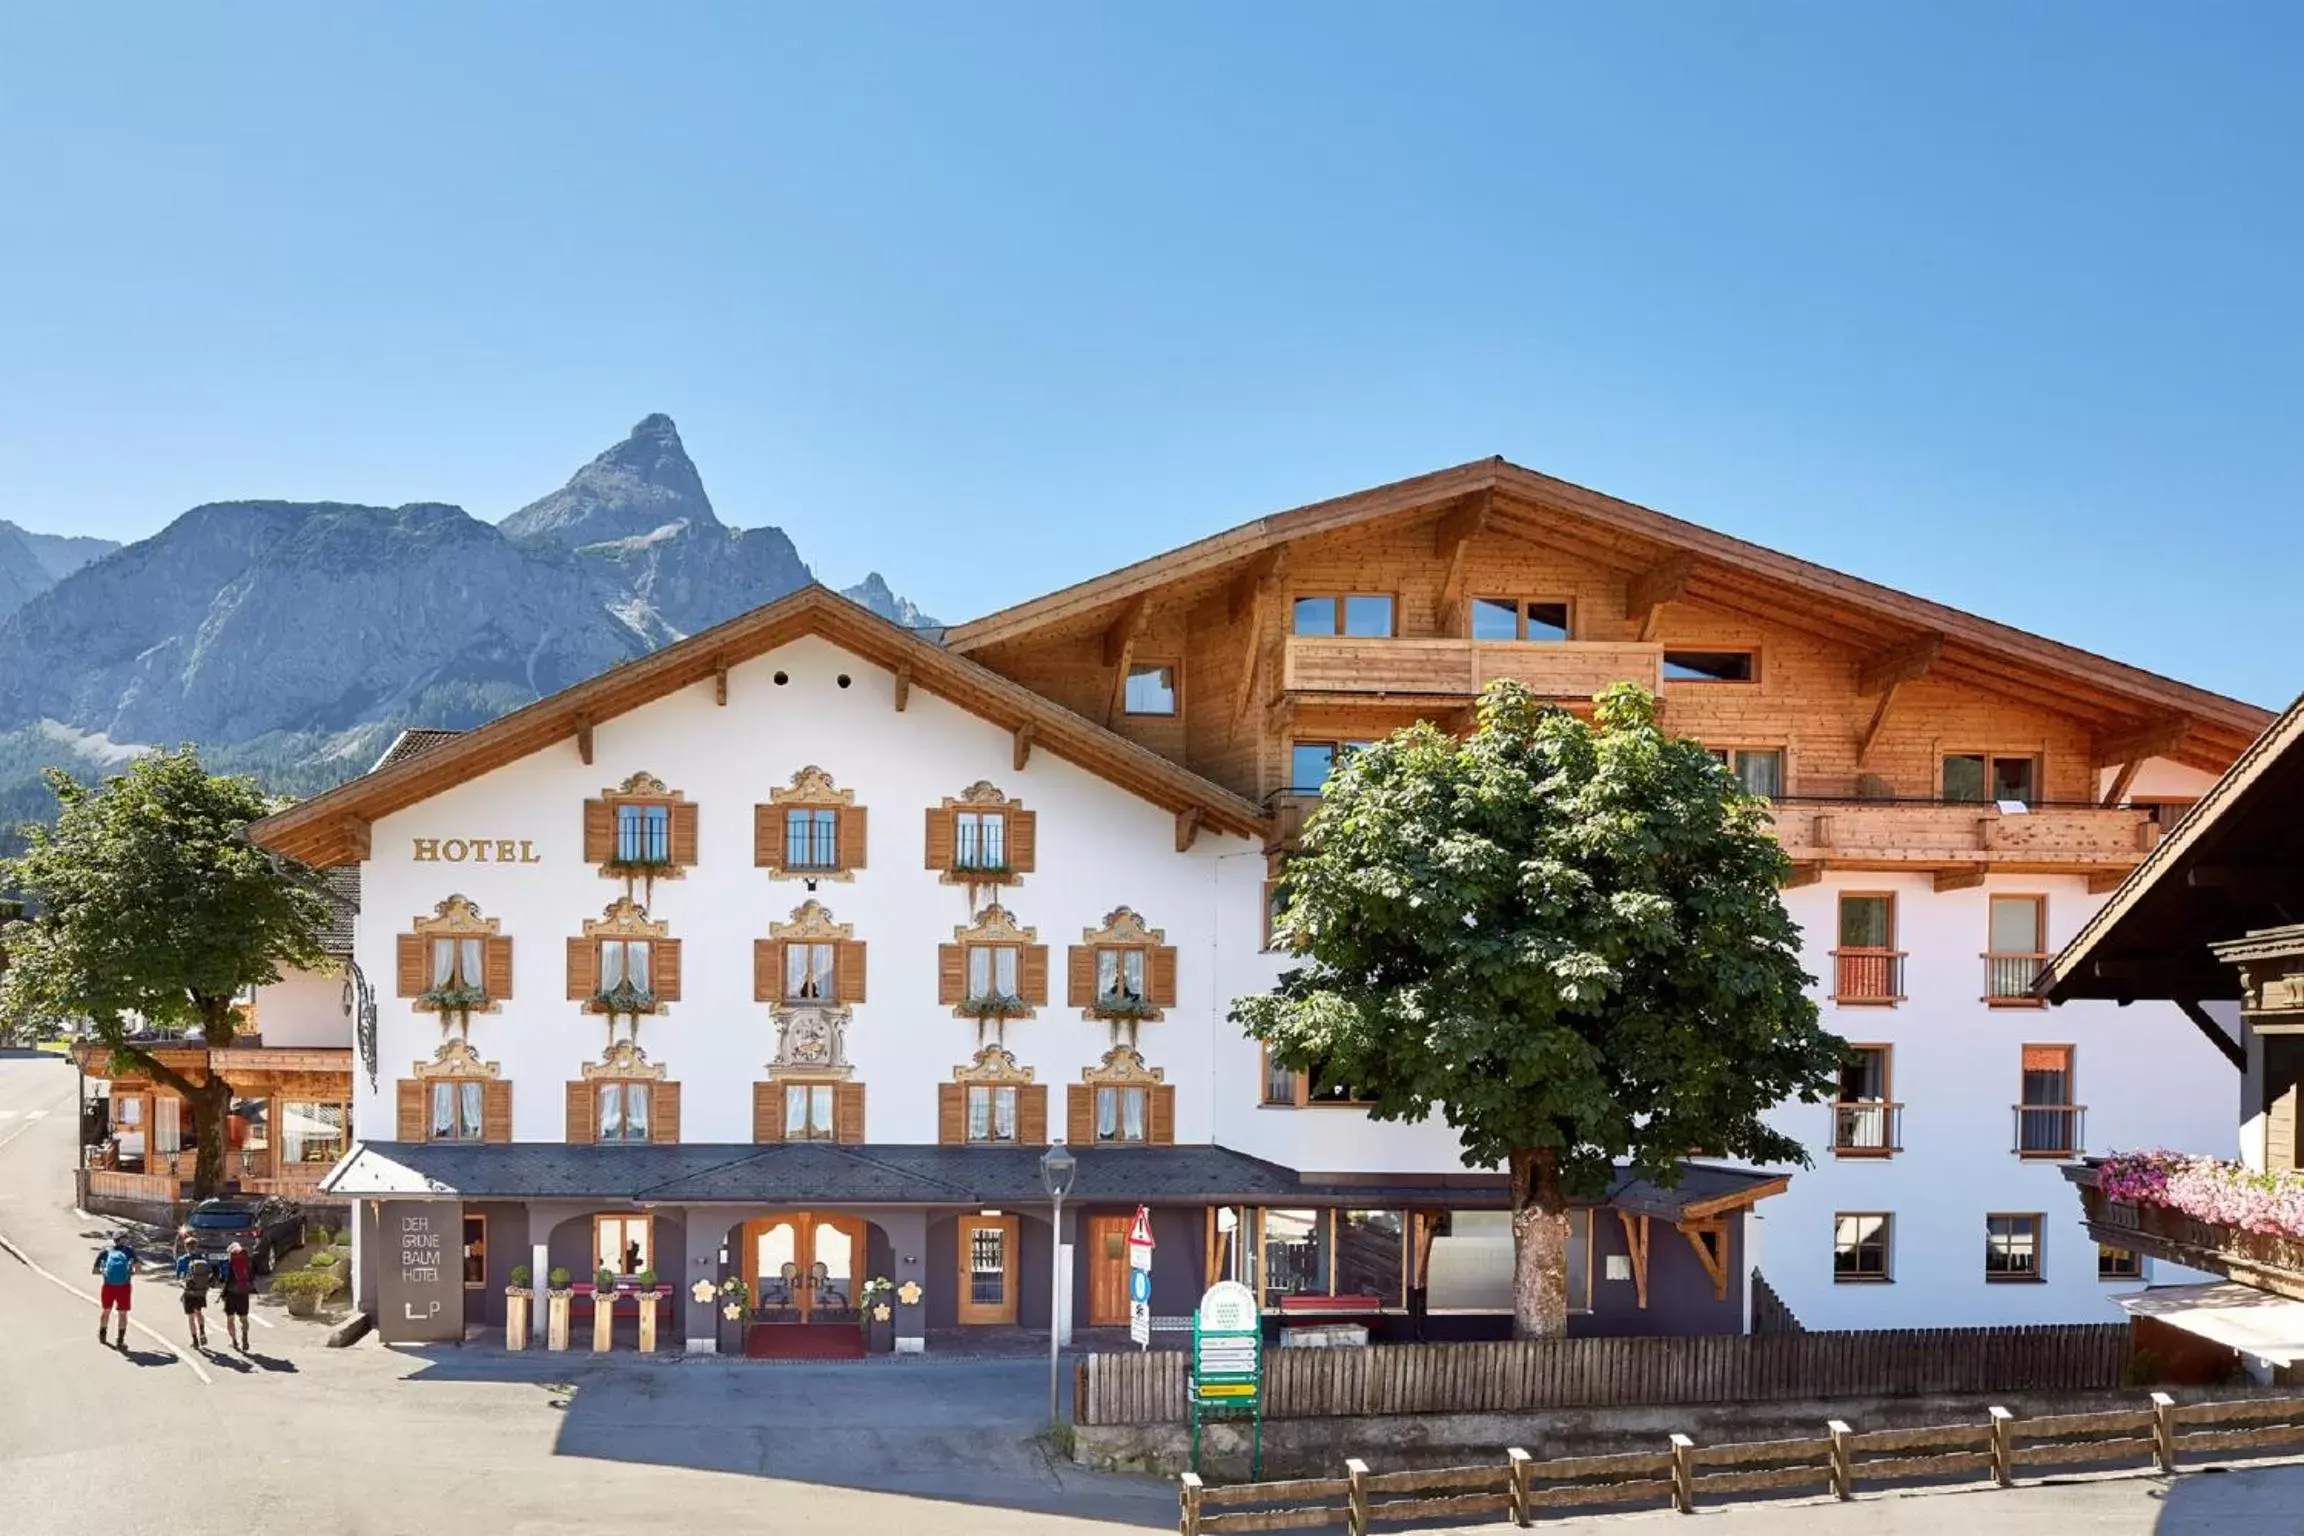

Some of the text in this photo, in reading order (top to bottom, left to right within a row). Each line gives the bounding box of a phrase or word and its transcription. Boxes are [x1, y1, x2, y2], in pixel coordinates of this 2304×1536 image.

[412, 838, 541, 864] HOTEL
[402, 1217, 428, 1231] DER
[402, 1268, 439, 1282] HOTEL
